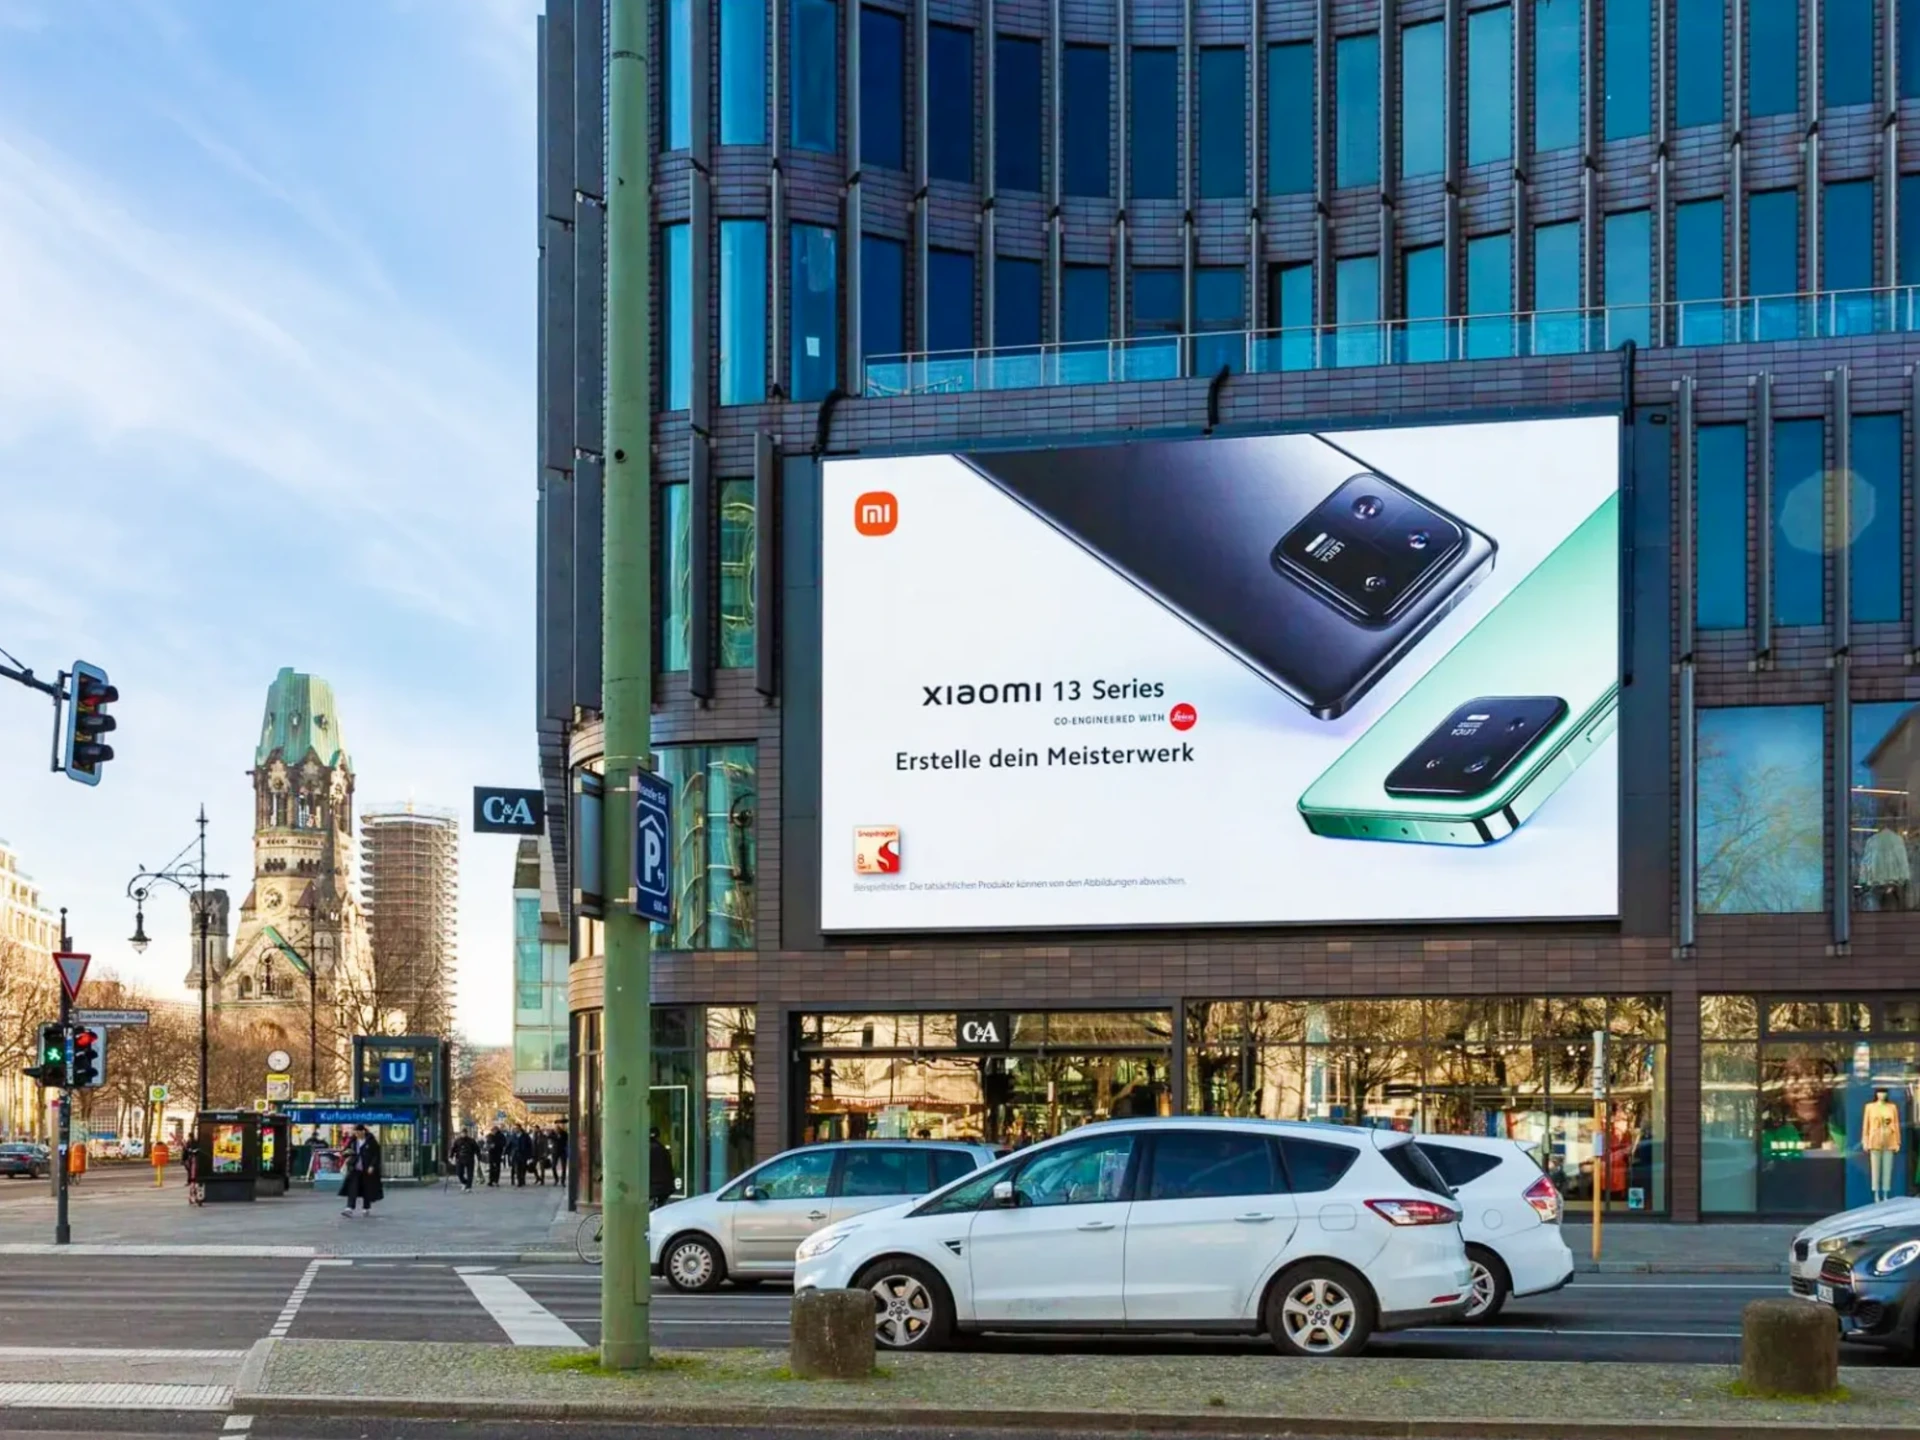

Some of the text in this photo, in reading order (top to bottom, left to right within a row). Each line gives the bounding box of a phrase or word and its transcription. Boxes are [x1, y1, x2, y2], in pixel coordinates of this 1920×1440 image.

[1321, 541, 1346, 562] LEICA
[1053, 680, 1082, 701] 13
[1092, 678, 1165, 700] Series
[1053, 714, 1136, 726] CO-ENGINEERED
[1138, 713, 1166, 723] WITH
[896, 743, 1195, 770] Erstelle dein Meisterwerk
[483, 796, 536, 825] C&A
[644, 828, 661, 883] P
[857, 853, 865, 865] 8
[909, 882, 923, 891] Die
[978, 880, 1015, 889] Produkte
[1065, 879, 1082, 887] den
[1083, 878, 1138, 888] Abbildungen
[962, 1021, 1000, 1043] C&A
[388, 1062, 408, 1083] U
